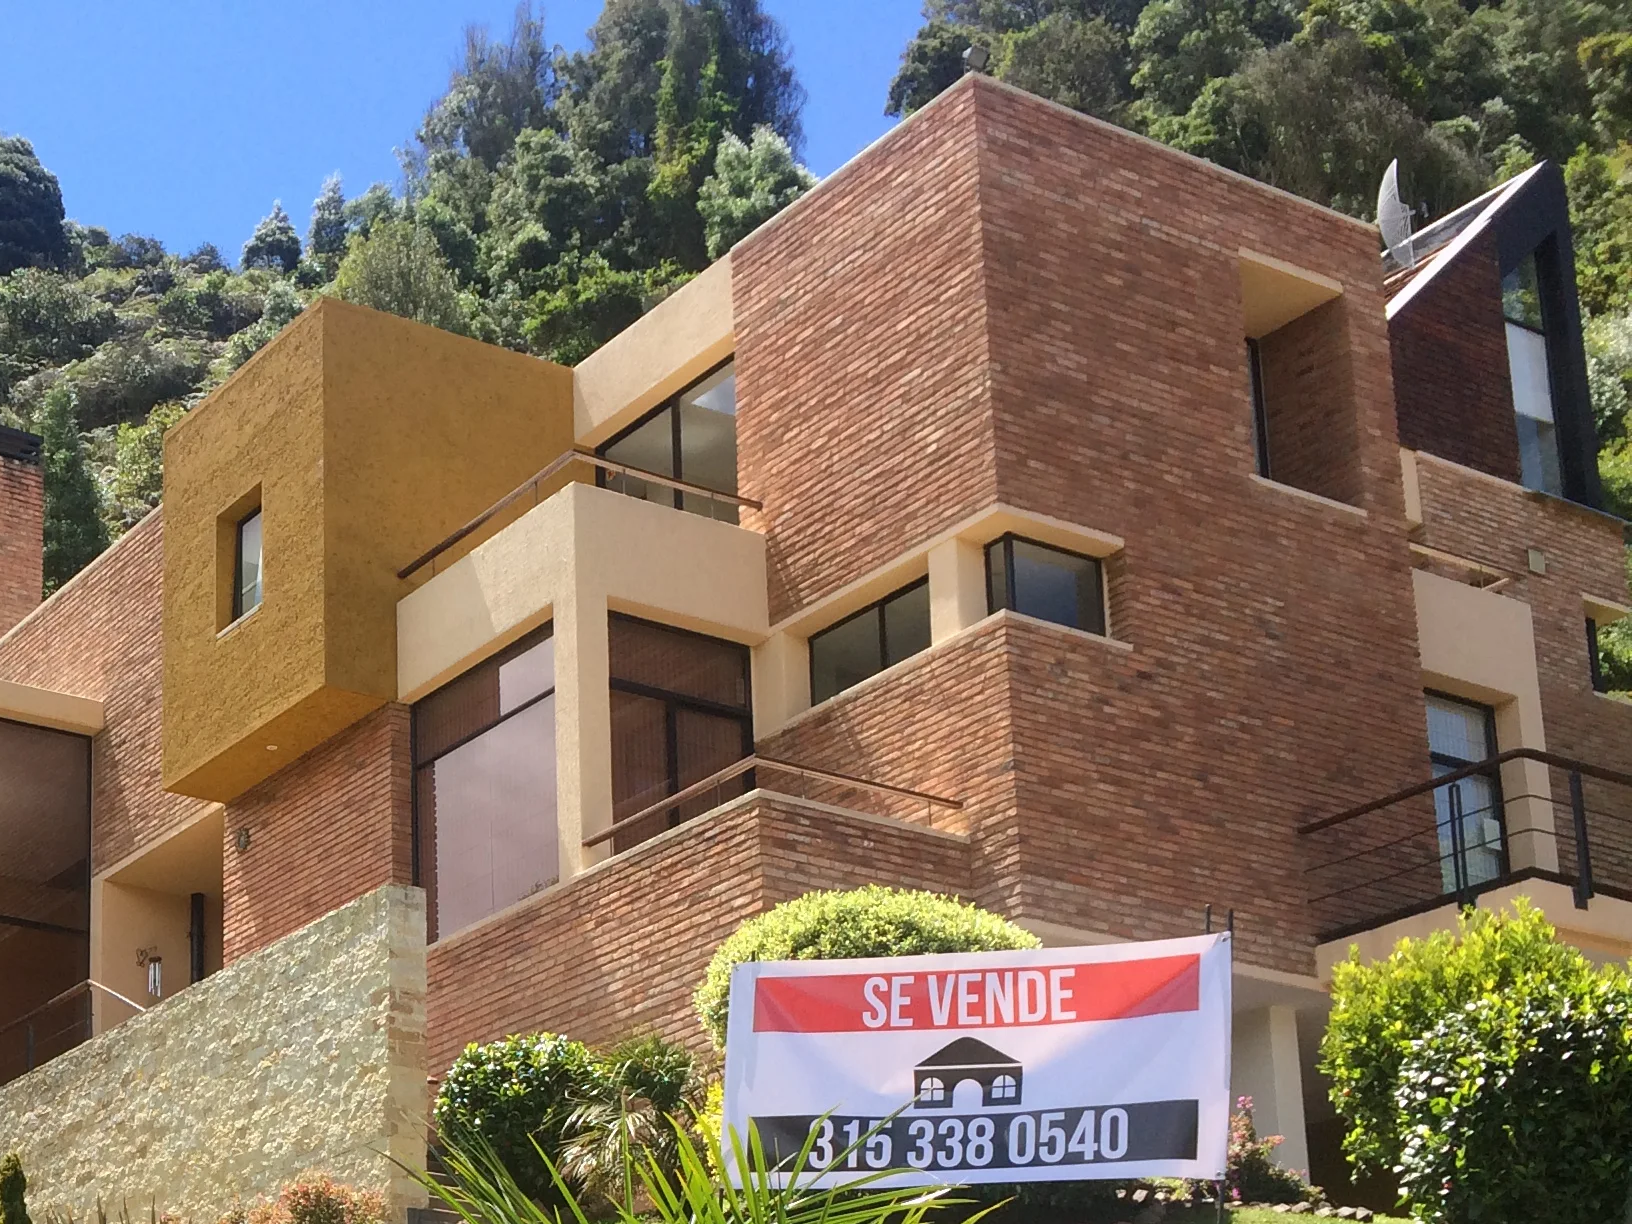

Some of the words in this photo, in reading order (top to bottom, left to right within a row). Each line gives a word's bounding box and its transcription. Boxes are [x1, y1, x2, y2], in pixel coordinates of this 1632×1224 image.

[863, 976, 913, 1028] SE
[928, 968, 1077, 1026] VENDE
[809, 1118, 893, 1169] 315
[908, 1117, 994, 1168] 338
[1009, 1107, 1129, 1164] 0540
